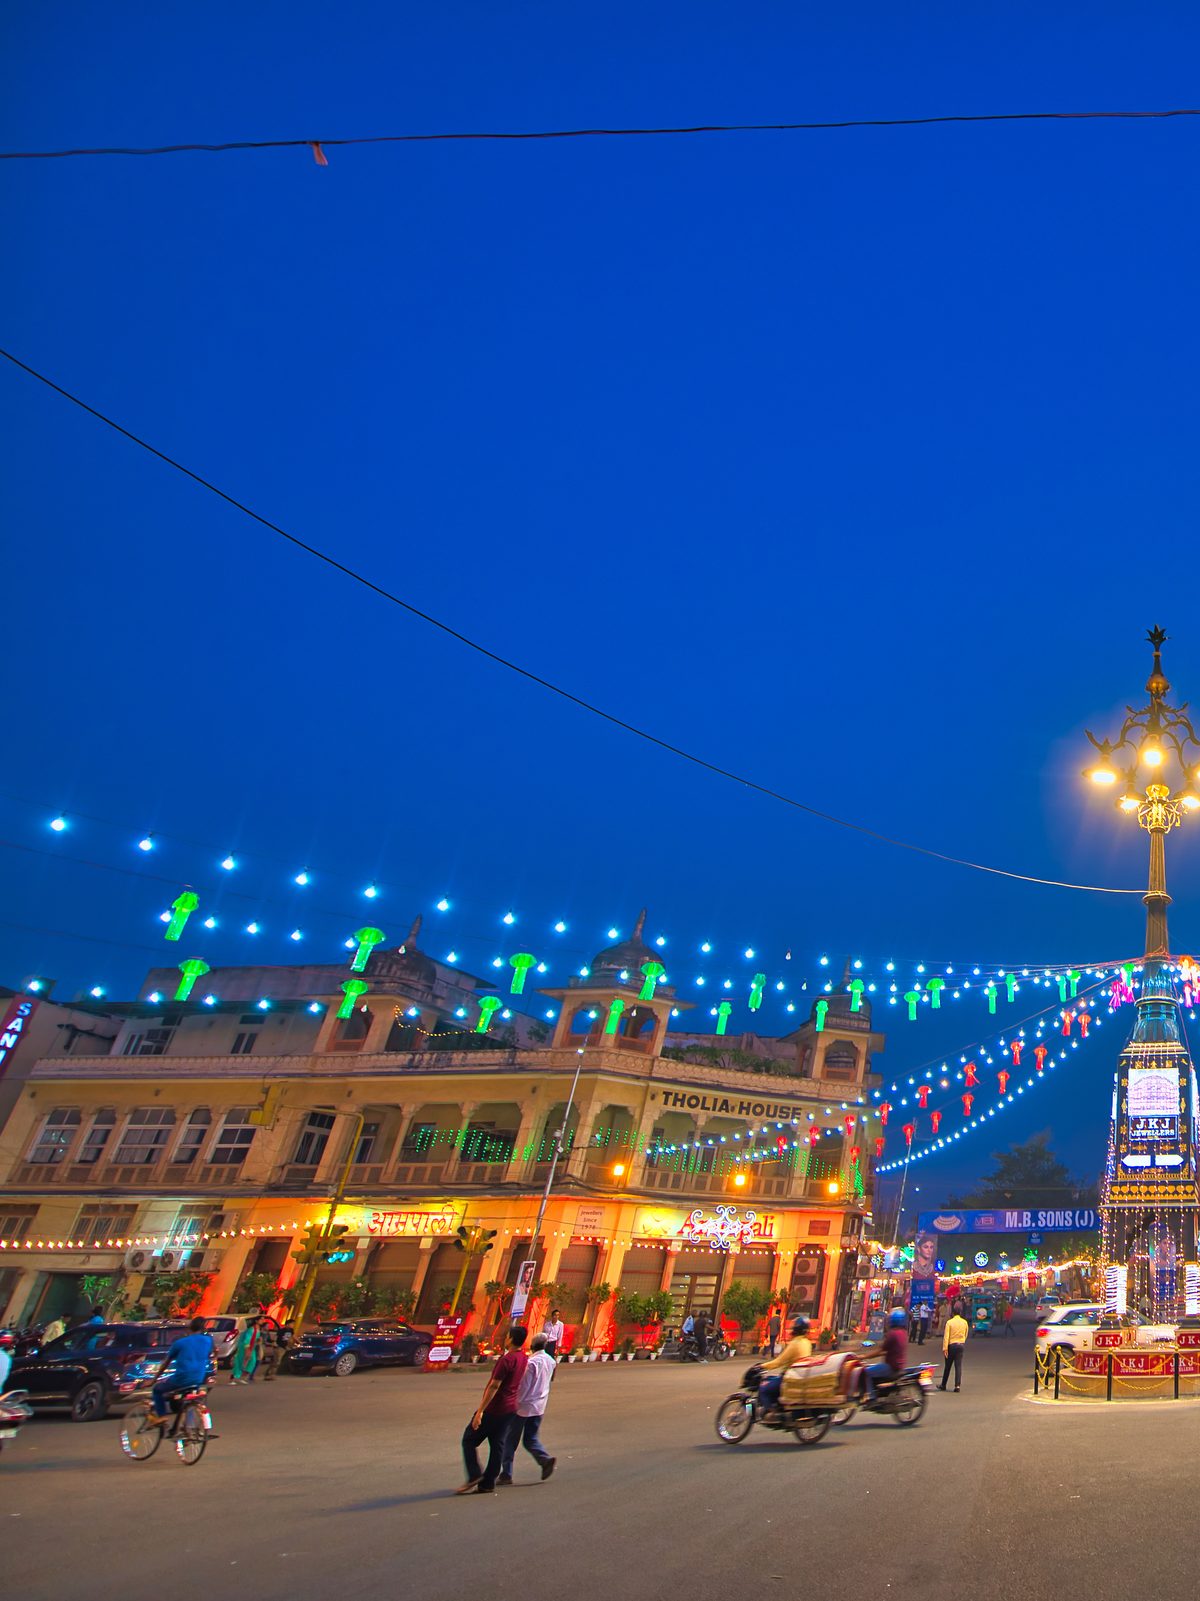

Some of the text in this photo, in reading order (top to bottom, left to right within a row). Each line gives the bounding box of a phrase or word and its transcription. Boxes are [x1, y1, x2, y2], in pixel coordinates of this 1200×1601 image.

[662, 1091, 802, 1120] THOLIA HOUSE
[1131, 1129, 1175, 1137] JEWELLERS
[1005, 1210, 1096, 1228] M.B. SONS (J)
